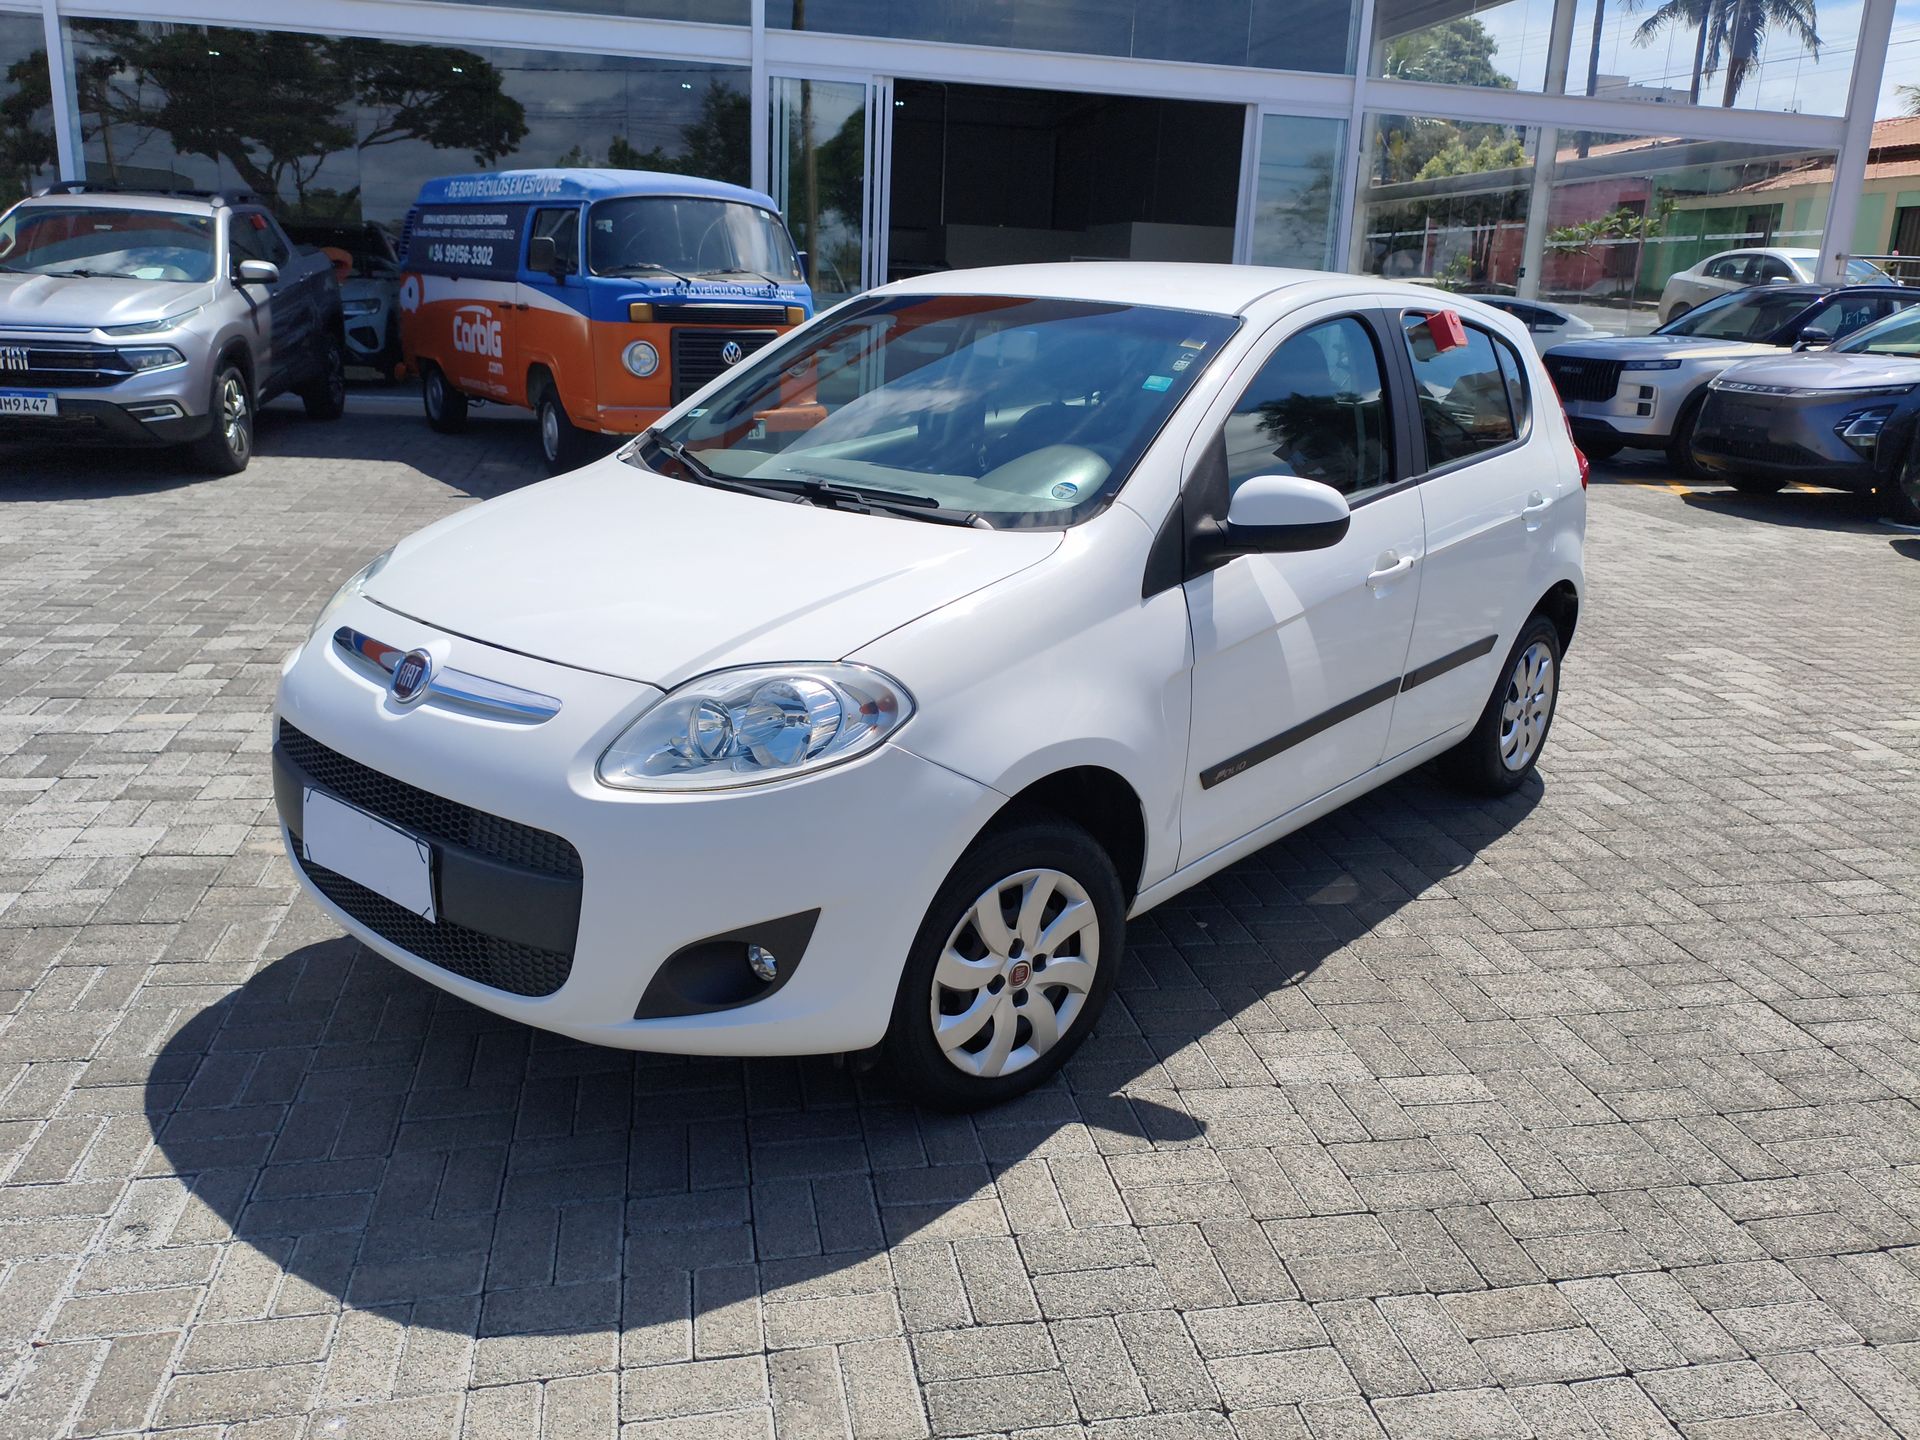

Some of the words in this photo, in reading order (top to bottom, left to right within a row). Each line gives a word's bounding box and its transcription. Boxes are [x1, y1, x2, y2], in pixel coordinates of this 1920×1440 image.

[448, 182, 459, 198] DE
[460, 182, 472, 197] 500
[472, 176, 510, 197] VEÍCULOS
[509, 177, 523, 194] EM
[522, 175, 562, 197] ESTOQUE
[433, 243, 443, 262] 34
[445, 245, 493, 266] 99156-3302
[661, 287, 674, 296] DE
[699, 285, 743, 296] VEÍCULOS
[744, 288, 758, 297] EM
[759, 288, 796, 300] ESTOQUE
[397, 662, 422, 689] FIAT
